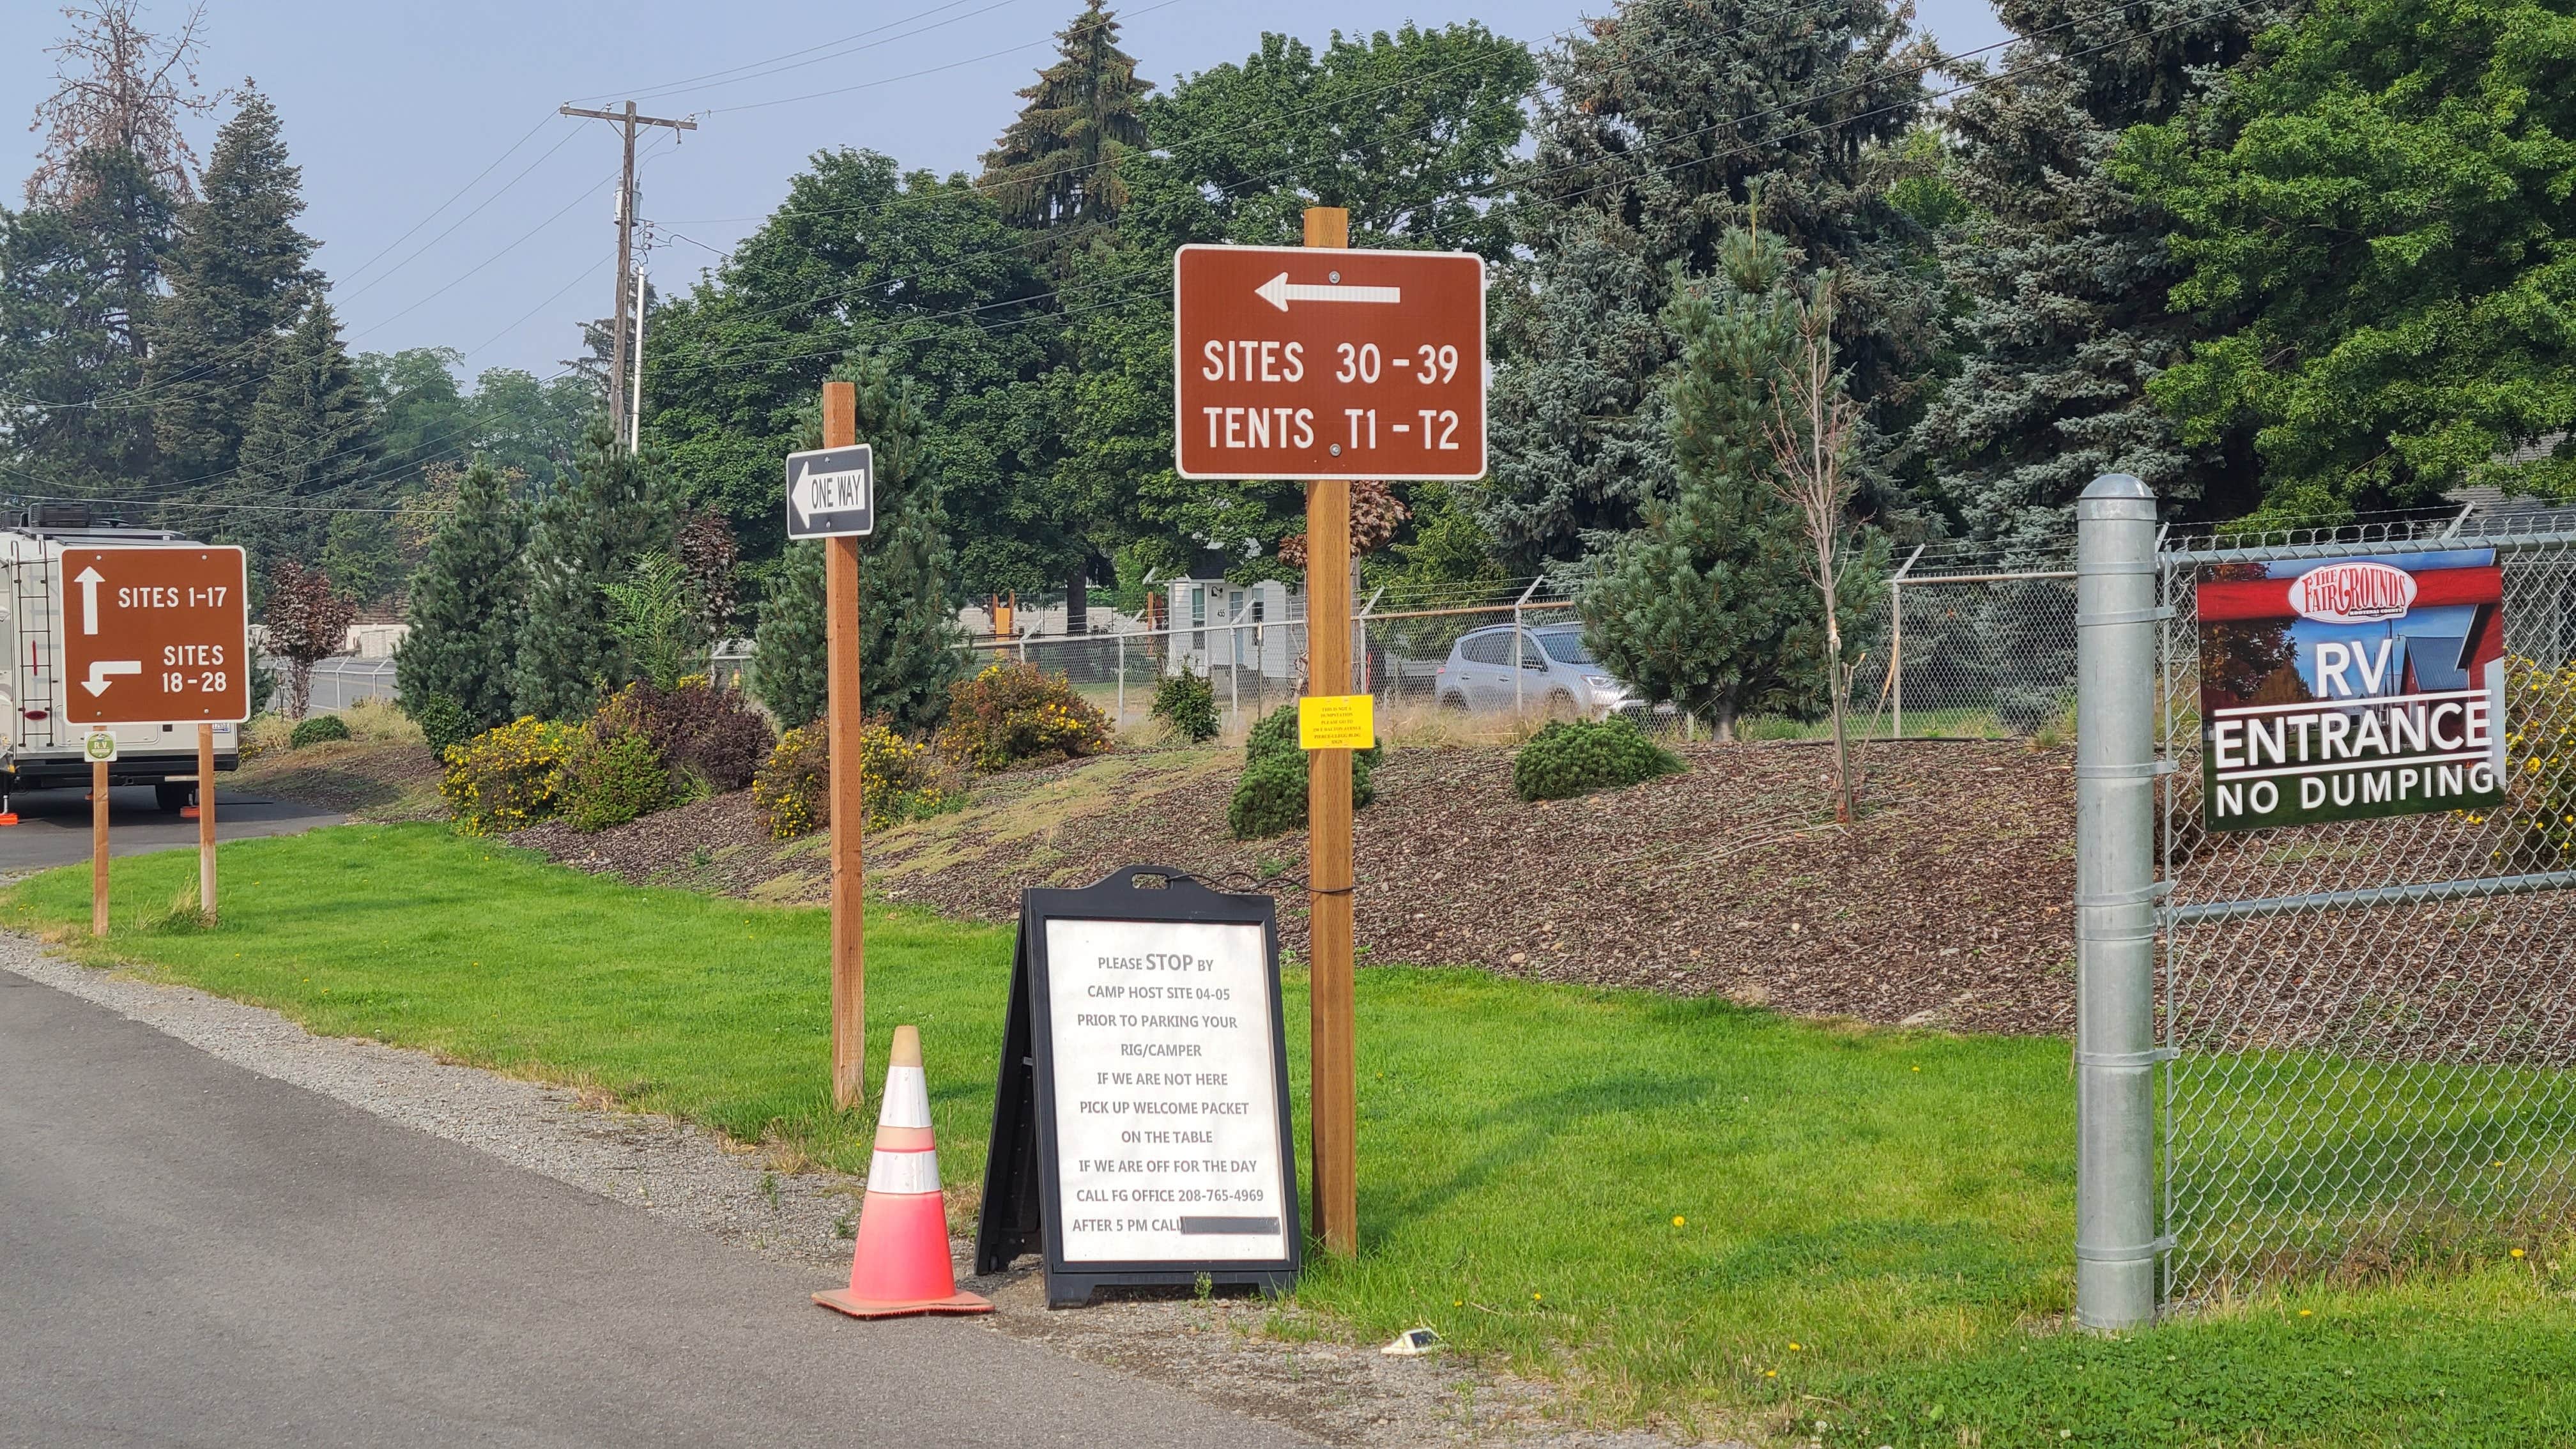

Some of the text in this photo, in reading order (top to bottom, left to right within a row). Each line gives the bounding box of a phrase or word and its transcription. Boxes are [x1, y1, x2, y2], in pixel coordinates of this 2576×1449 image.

[1202, 340, 1304, 382] SITES
[1203, 407, 1314, 448] TENTS
[811, 474, 861, 509] ONE WAY
[2314, 569, 2337, 586] THE
[119, 586, 227, 608] SITES 1-17
[164, 645, 224, 666] SITES
[2317, 639, 2393, 698] RV
[2215, 701, 2493, 769] ENTRANCE
[2218, 762, 2494, 817] NO DUMPING
[1098, 953, 1214, 972] PLEASE STOP BY
[1087, 985, 1230, 1000] CAMP HOST SITE 04-05
[1077, 1013, 1238, 1029] PRIOR TO PARKING YOUR
[1121, 1043, 1202, 1058] RIG/CAMPER
[1097, 1072, 1228, 1085] IF WE ARE NOT HERE
[1080, 1101, 1250, 1115] PICK UP WELCOME PACKET
[1121, 1130, 1213, 1144] ON THE TABLE
[1078, 1160, 1257, 1173] IF WE ARE OFF FOR THE DAY
[1077, 1189, 1264, 1202] CALL FG OFFICE 208-765-4969
[1072, 1218, 1181, 1232] AFTER 5 PM CALL
